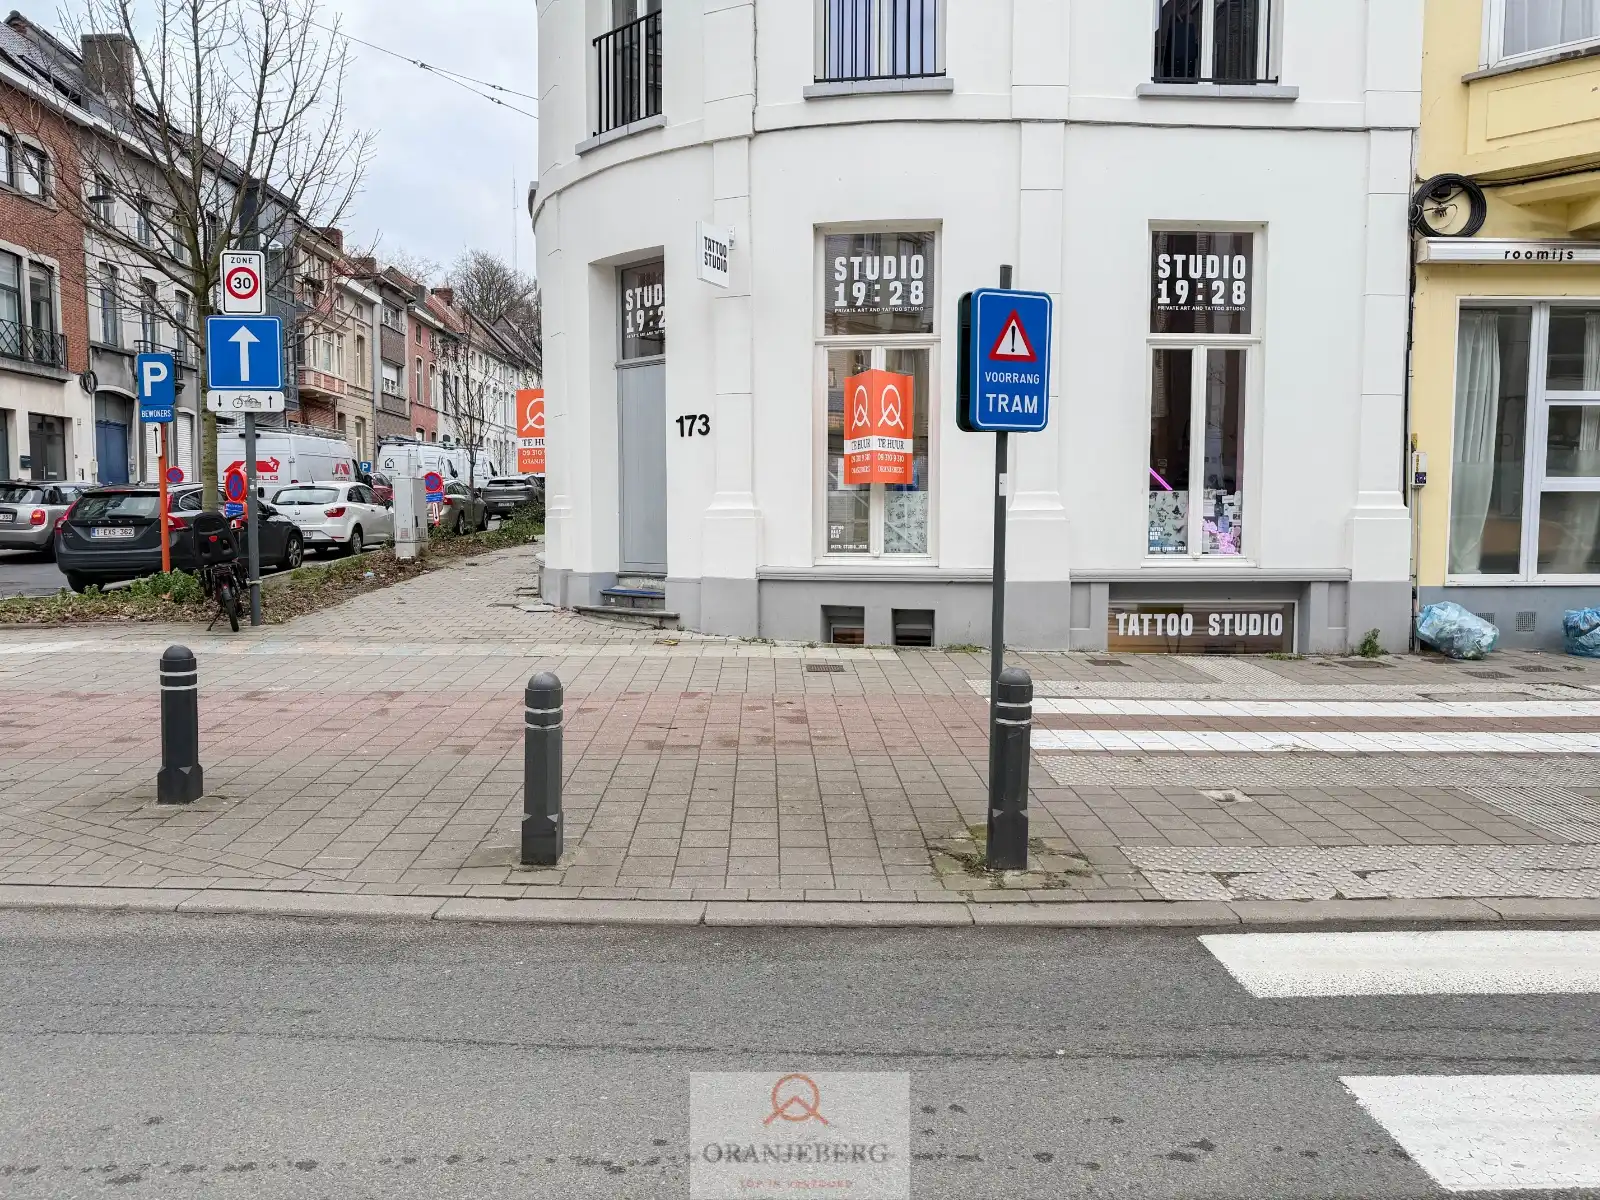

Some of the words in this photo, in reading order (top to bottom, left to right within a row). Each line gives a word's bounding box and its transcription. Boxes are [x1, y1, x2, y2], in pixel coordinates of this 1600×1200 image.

[704, 236, 727, 258] TATTOO
[1505, 249, 1573, 262] roomijs
[704, 252, 727, 273] STUDIO
[834, 255, 924, 281] STUDIO
[1158, 253, 1246, 279] STUDIO
[234, 278, 251, 289] 30
[834, 280, 924, 306] 19:28
[1158, 280, 1246, 305] 19:28
[143, 362, 168, 397] P
[985, 372, 1040, 385] VOORRANG
[141, 410, 172, 418] BEWONERS
[986, 393, 1038, 414] TRAM
[675, 413, 711, 437] 173
[1116, 613, 1193, 636] TATTOO
[1208, 613, 1283, 636] STUDIO
